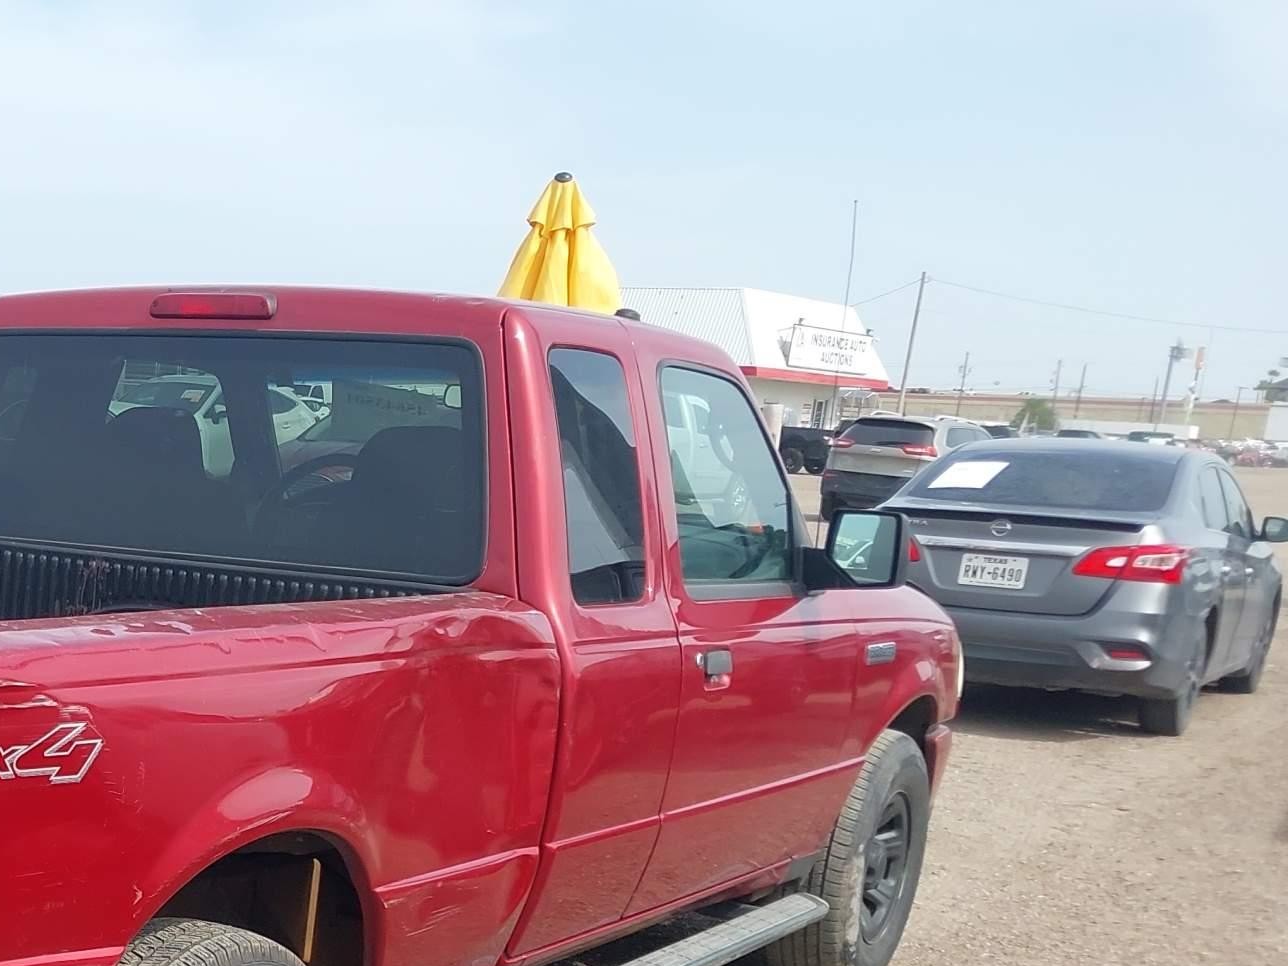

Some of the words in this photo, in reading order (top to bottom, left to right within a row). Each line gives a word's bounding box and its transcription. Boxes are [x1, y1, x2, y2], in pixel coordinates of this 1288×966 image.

[811, 333, 848, 350] INSURANCE
[850, 339, 867, 352] AUTO
[820, 351, 853, 367] AUCTIONS
[983, 556, 1008, 564] TEXAS
